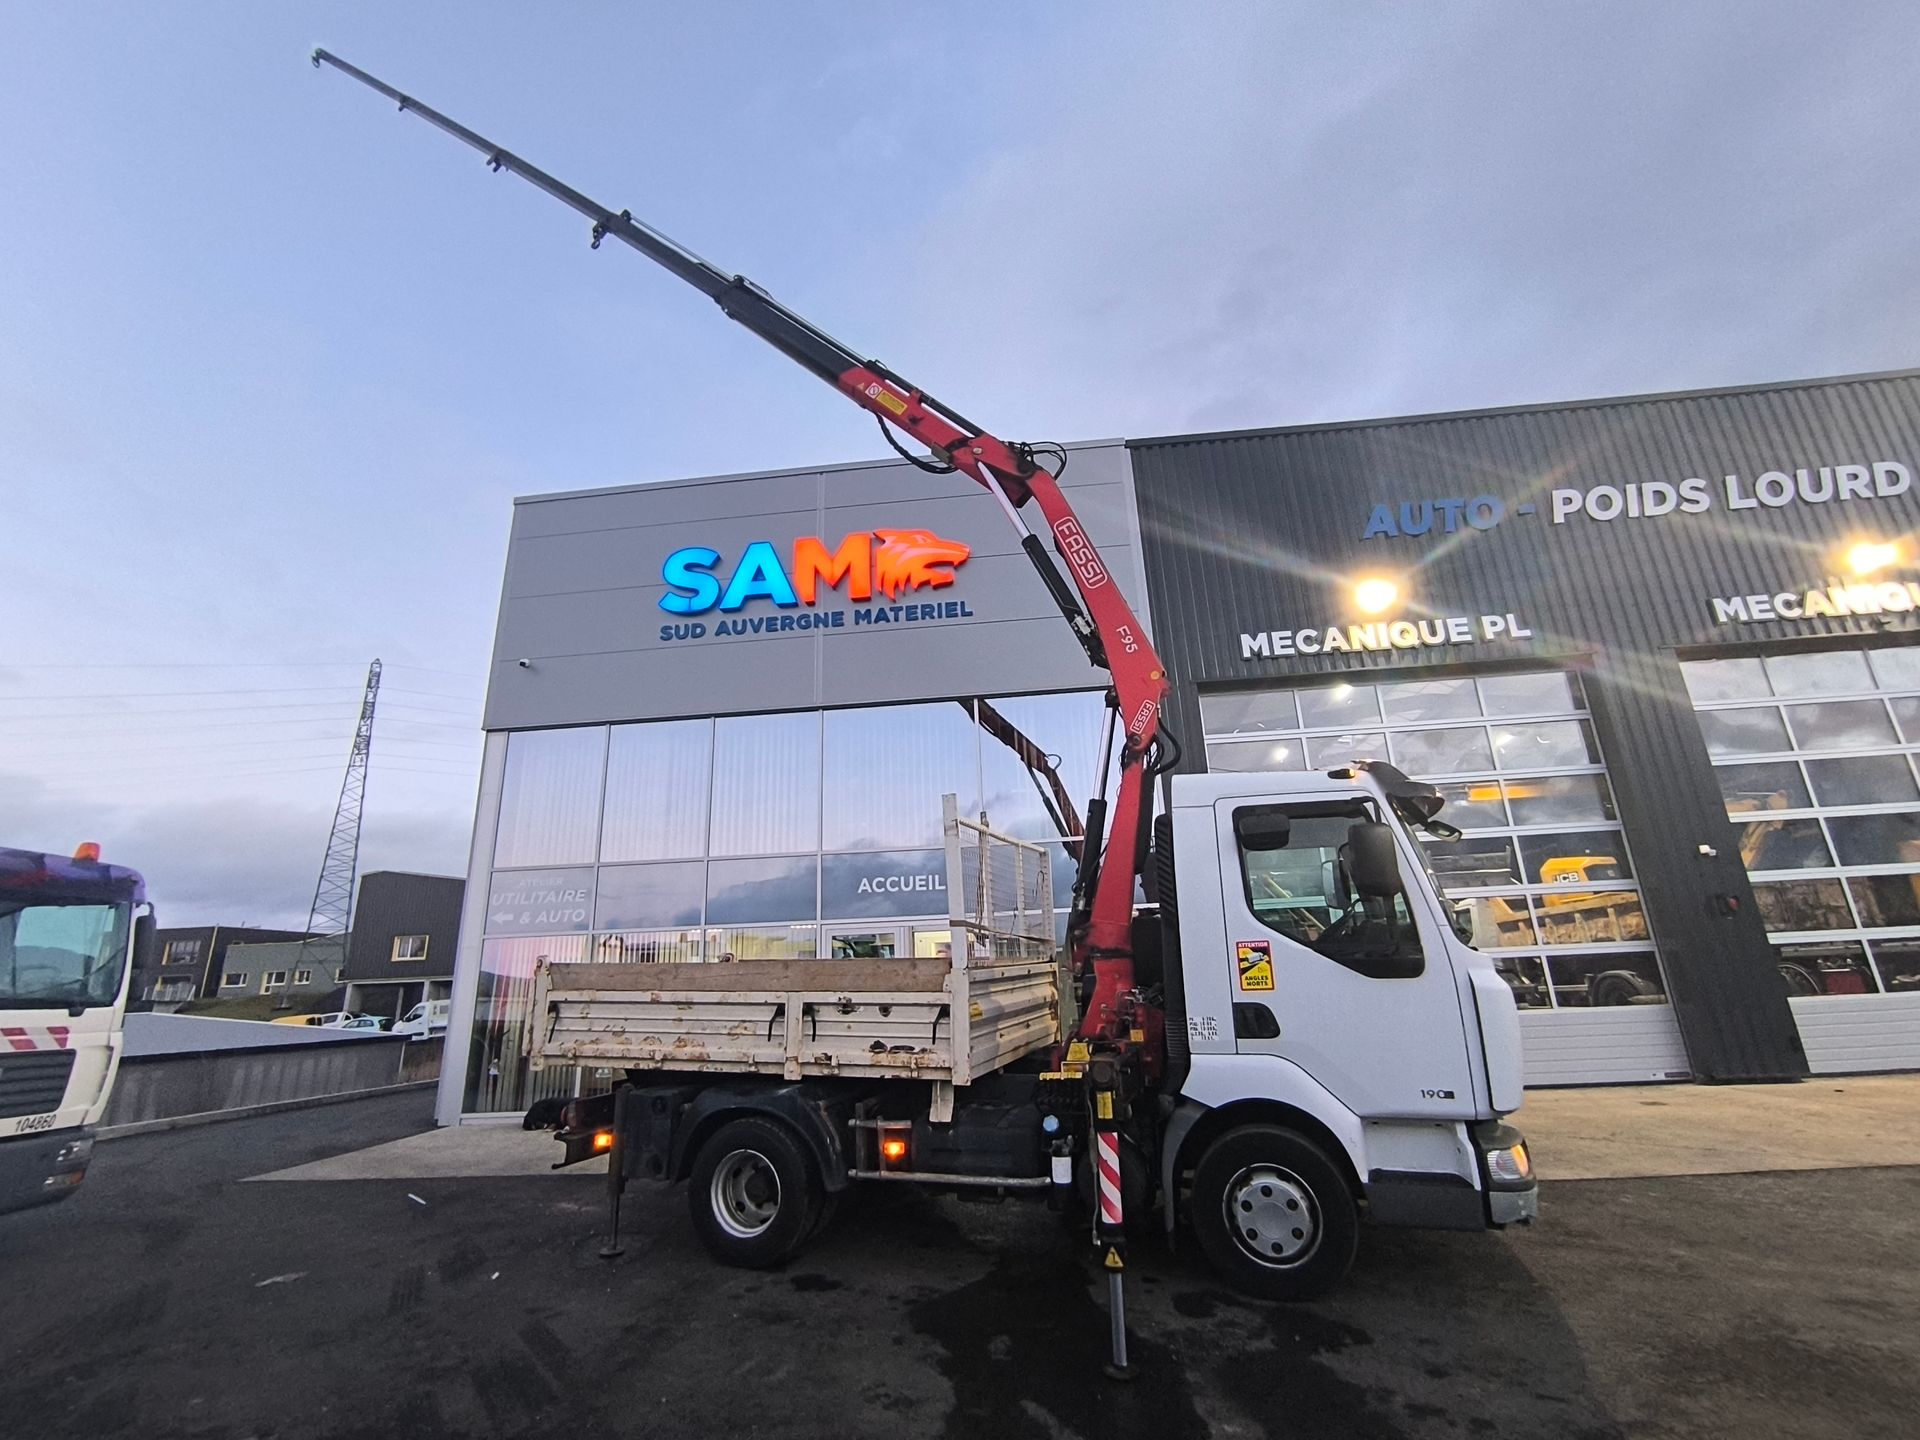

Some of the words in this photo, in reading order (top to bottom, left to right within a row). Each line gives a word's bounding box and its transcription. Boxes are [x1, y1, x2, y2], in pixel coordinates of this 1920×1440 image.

[1363, 495, 1502, 540] AUTO
[1551, 478, 1711, 525] POIDS
[1725, 460, 1912, 511] LOURD
[1058, 521, 1102, 584] FASSI
[658, 530, 873, 617] SAM
[659, 623, 706, 642] SUD
[714, 611, 844, 637] AUVERGNE
[854, 600, 974, 625] MATERIEL
[1239, 616, 1475, 660] MECANIQUE
[1481, 613, 1533, 643] PL
[1116, 624, 1139, 654] F95
[1132, 701, 1154, 733] FASSI
[857, 874, 947, 894] ACCUEIL
[1554, 872, 1579, 884] JCB
[492, 889, 587, 906] UTILITAIRE
[534, 908, 586, 924] AUTO
